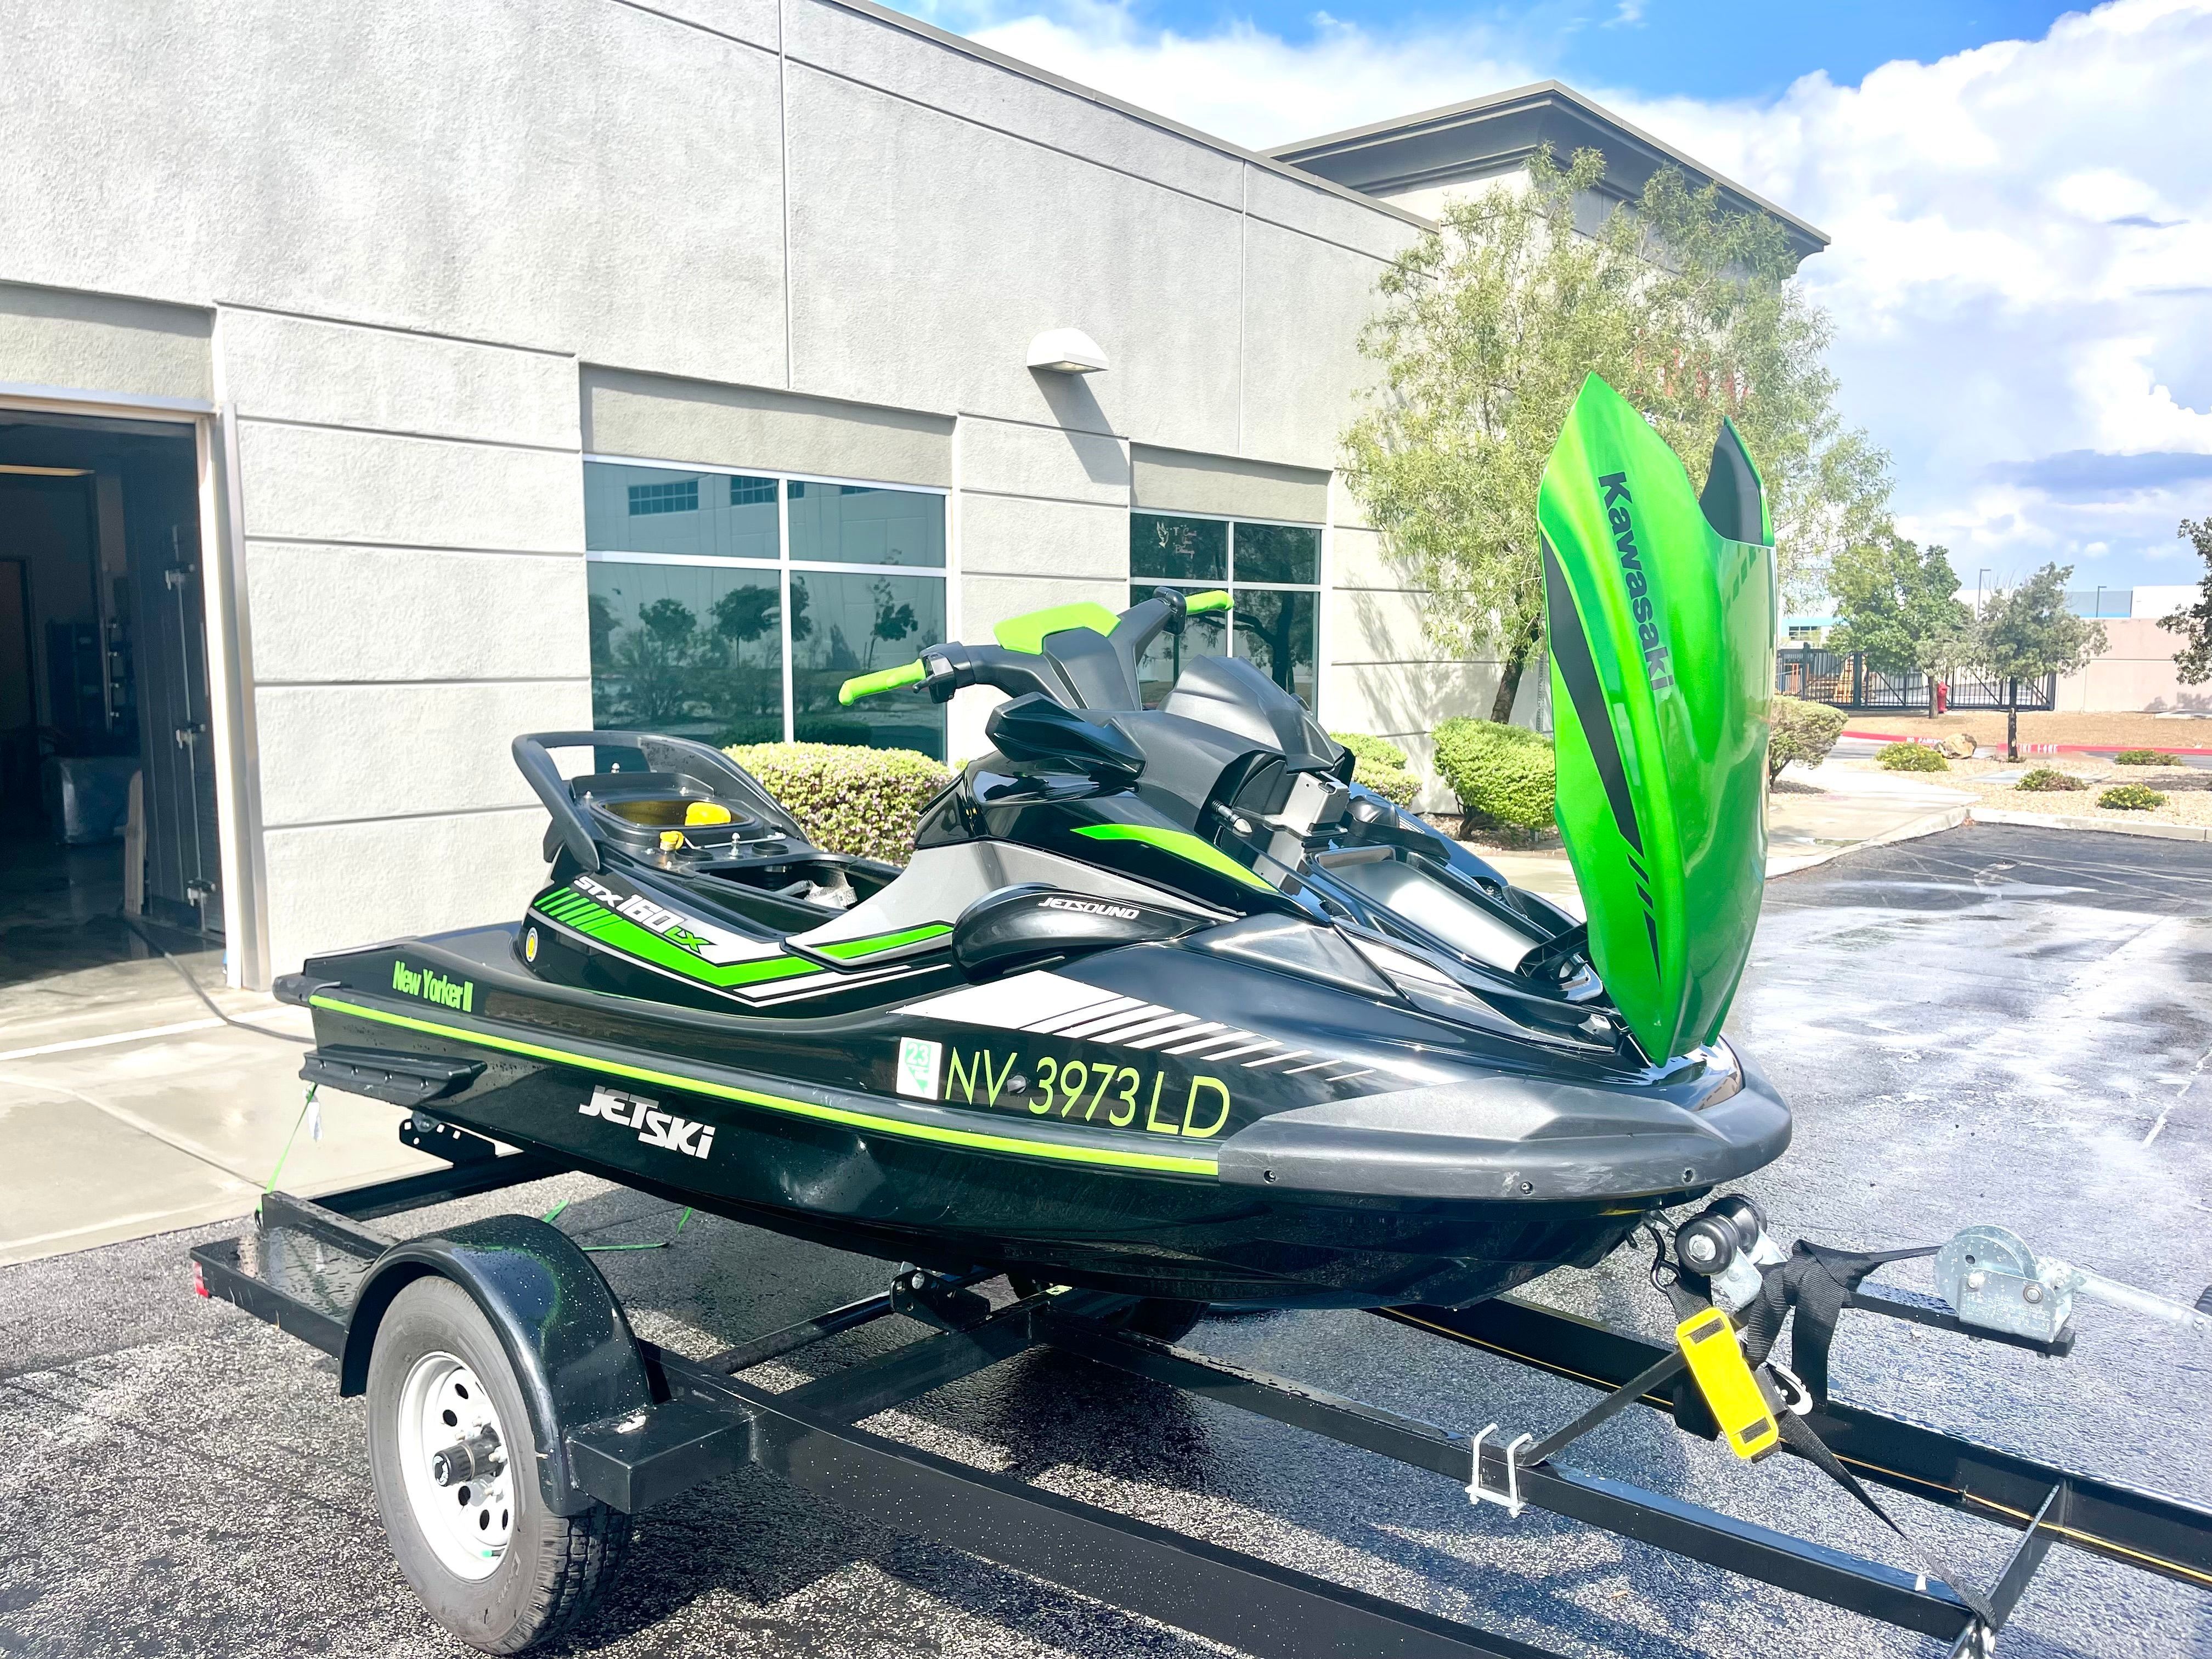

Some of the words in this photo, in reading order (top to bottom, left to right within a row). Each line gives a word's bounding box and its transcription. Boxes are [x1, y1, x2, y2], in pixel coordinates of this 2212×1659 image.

[1598, 472, 1674, 691] Kawasaki
[1037, 897, 1140, 919] JETSOUND
[393, 960, 422, 996] New
[423, 968, 463, 1009] Yorker
[906, 1042, 929, 1065] 23
[945, 1047, 1018, 1108] NV
[1029, 1057, 1140, 1127] 3973
[1146, 1070, 1230, 1138] LD
